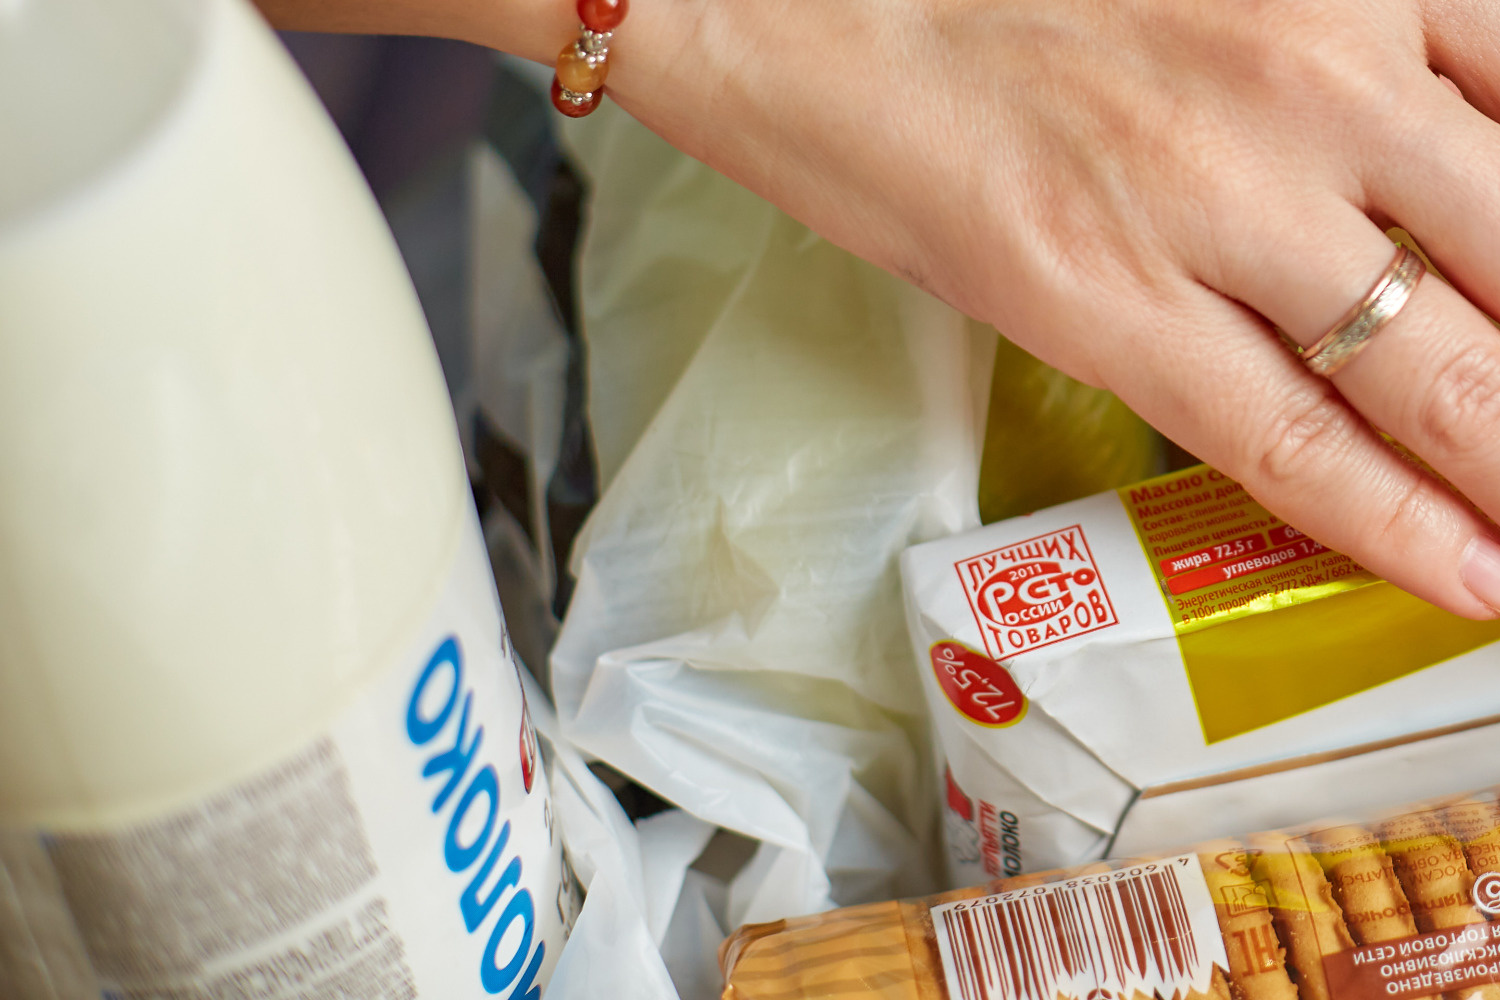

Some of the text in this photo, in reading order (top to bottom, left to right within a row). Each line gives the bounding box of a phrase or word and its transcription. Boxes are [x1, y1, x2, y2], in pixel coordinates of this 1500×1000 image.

[1130, 471, 1201, 505] Масло
[1138, 490, 1213, 520] Массовая
[1143, 513, 1189, 531] Состав:
[1154, 534, 1210, 558] Пищевая
[1212, 519, 1268, 541] ценность
[967, 531, 1086, 592] ЛУЧШИХ
[1009, 563, 1043, 581] 2011
[1172, 552, 1211, 572] жира
[1214, 541, 1245, 560] 72,5
[1223, 547, 1296, 580] углеводов
[1176, 574, 1263, 611] Энергетическая
[1264, 563, 1313, 584] ценность
[986, 588, 1108, 654] ТОВАРОВ
[937, 648, 1015, 720] 72,5%
[951, 855, 1190, 914] 4 606038 072079
[1343, 888, 1473, 930] Пятрочка
[1352, 944, 1396, 965] СЕТИ
[1398, 924, 1487, 957] ТОРГОВОЙ
